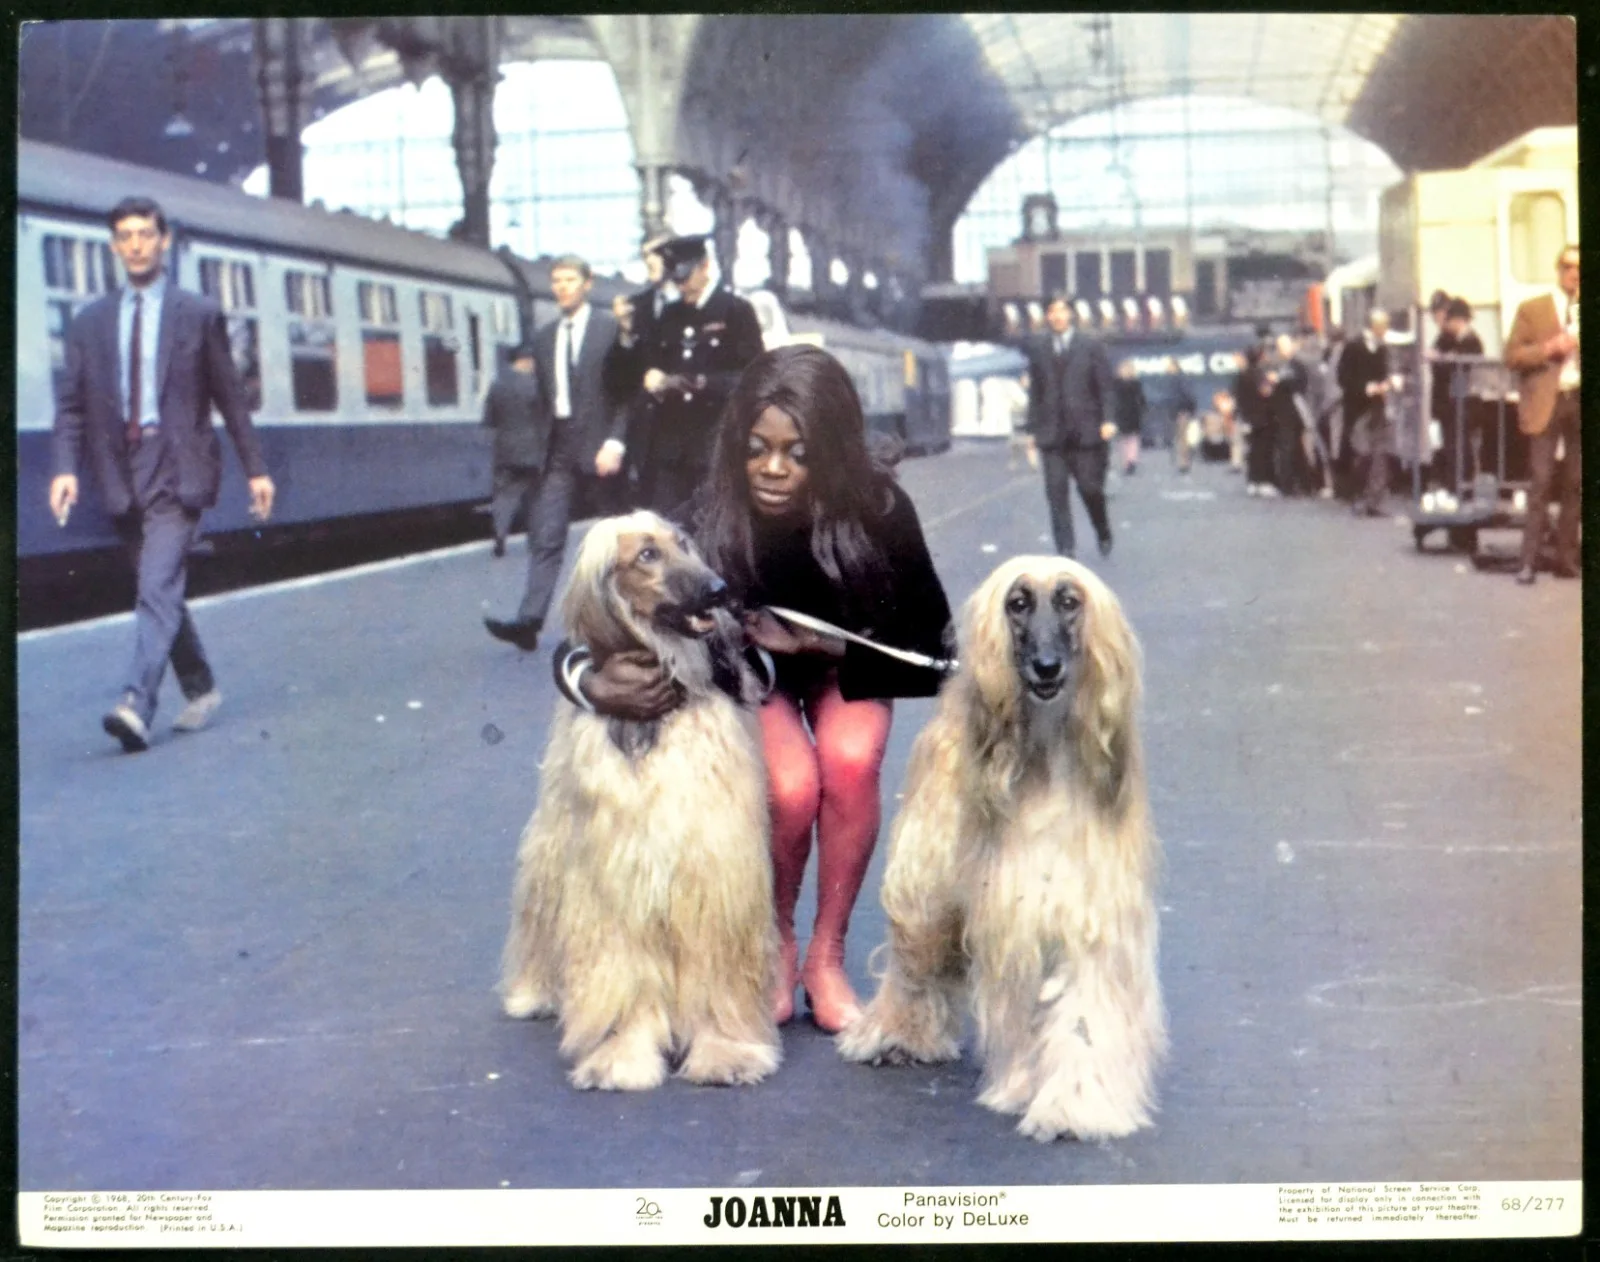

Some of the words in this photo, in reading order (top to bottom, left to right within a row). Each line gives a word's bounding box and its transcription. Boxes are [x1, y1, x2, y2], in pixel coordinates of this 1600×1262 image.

[1279, 1187, 1314, 1195] Property
[1420, 1184, 1450, 1192] Service
[1279, 1196, 1315, 1204] Licensed
[1338, 1196, 1368, 1204] display
[1412, 1194, 1457, 1202] connection
[1501, 1195, 1565, 1212] 68/277
[144, 1204, 168, 1212] rights
[703, 1196, 846, 1228] JOANNA
[1297, 1205, 1340, 1213] exhibition
[1425, 1204, 1443, 1212] your
[129, 1213, 141, 1221] for
[196, 1213, 212, 1221] and
[878, 1213, 924, 1227] Color
[934, 1213, 954, 1230] by
[963, 1212, 1029, 1226] DeLuxe
[1279, 1215, 1299, 1223] Must
[1308, 1215, 1318, 1223] be
[1372, 1213, 1424, 1222] immediately
[44, 1224, 85, 1232] Magazine
